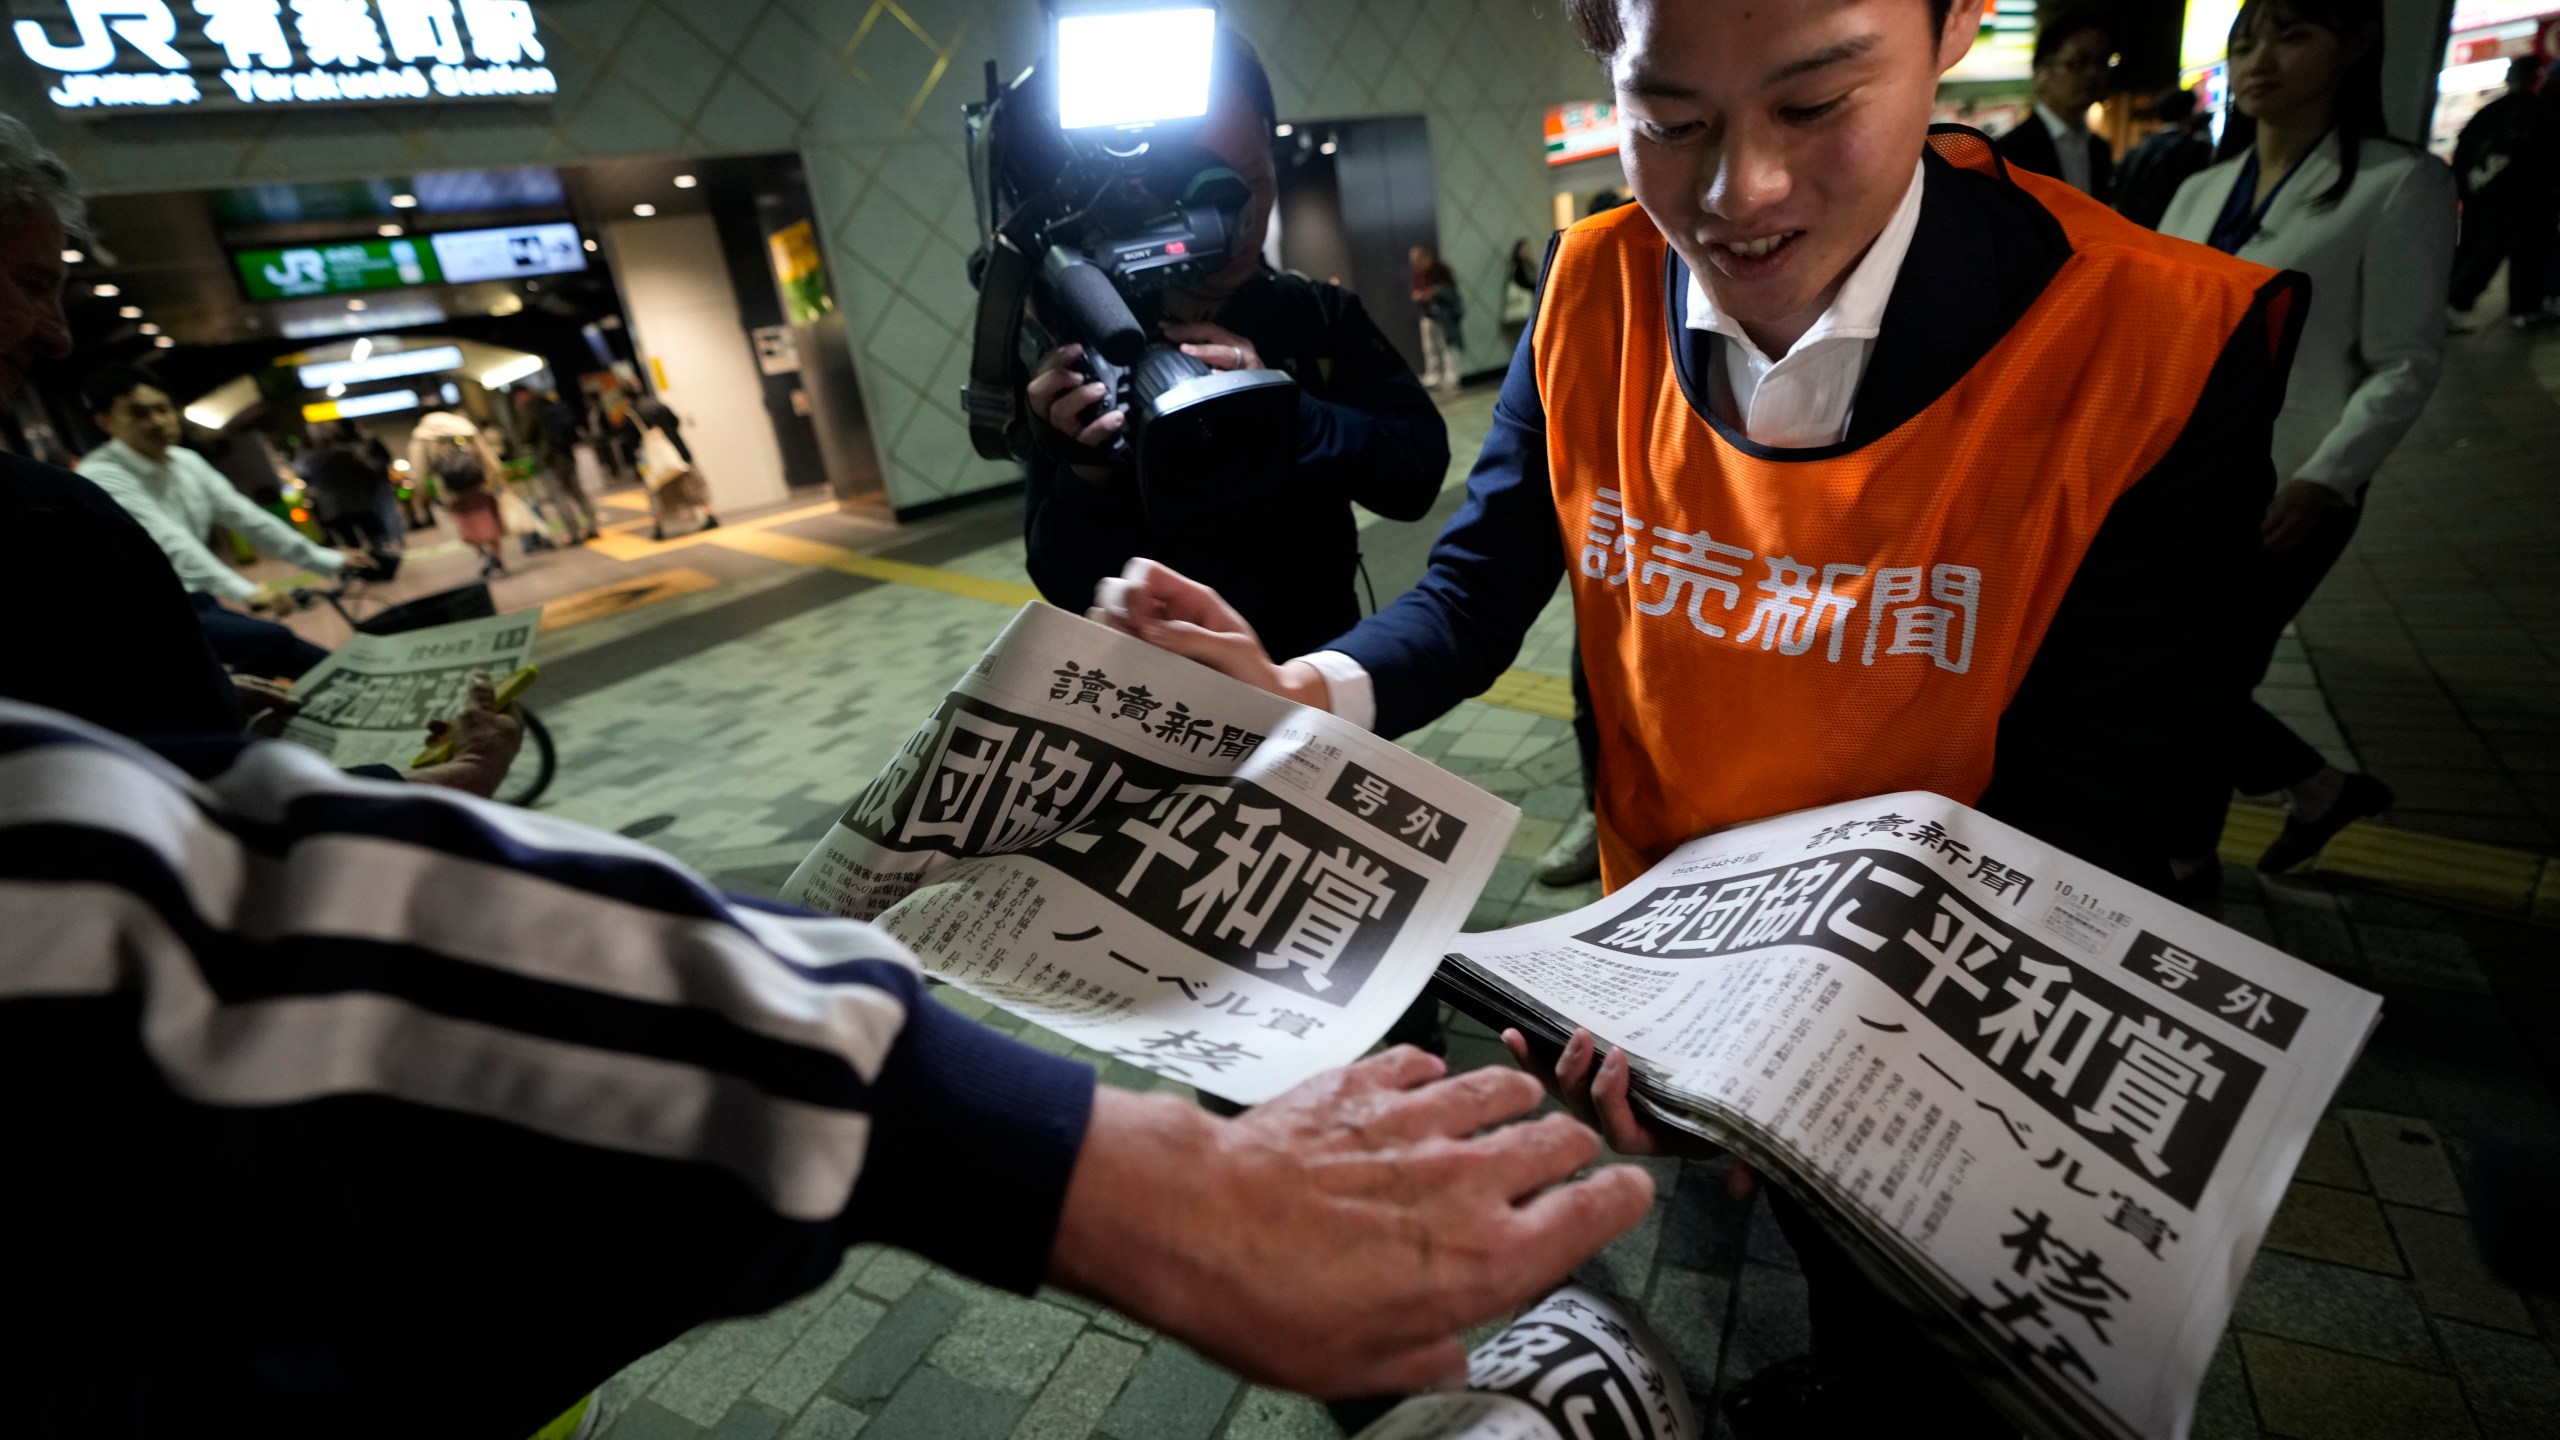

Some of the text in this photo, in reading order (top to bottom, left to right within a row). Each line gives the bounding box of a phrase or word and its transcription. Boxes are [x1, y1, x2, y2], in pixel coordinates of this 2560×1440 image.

[14, 0, 190, 72] JR
[264, 248, 328, 287] JR
[1123, 248, 1152, 262] SONY
[1580, 486, 1982, 675] 読売新聞
[853, 698, 1395, 992] 被団協に平和賞
[1350, 773, 1444, 848] 号外
[1052, 923, 1329, 1041] ノーベル賞
[1605, 853, 2227, 1180] 被団協に平和賞
[2148, 945, 2278, 1033] 号外
[1859, 1014, 2182, 1262] ノーベル賞
